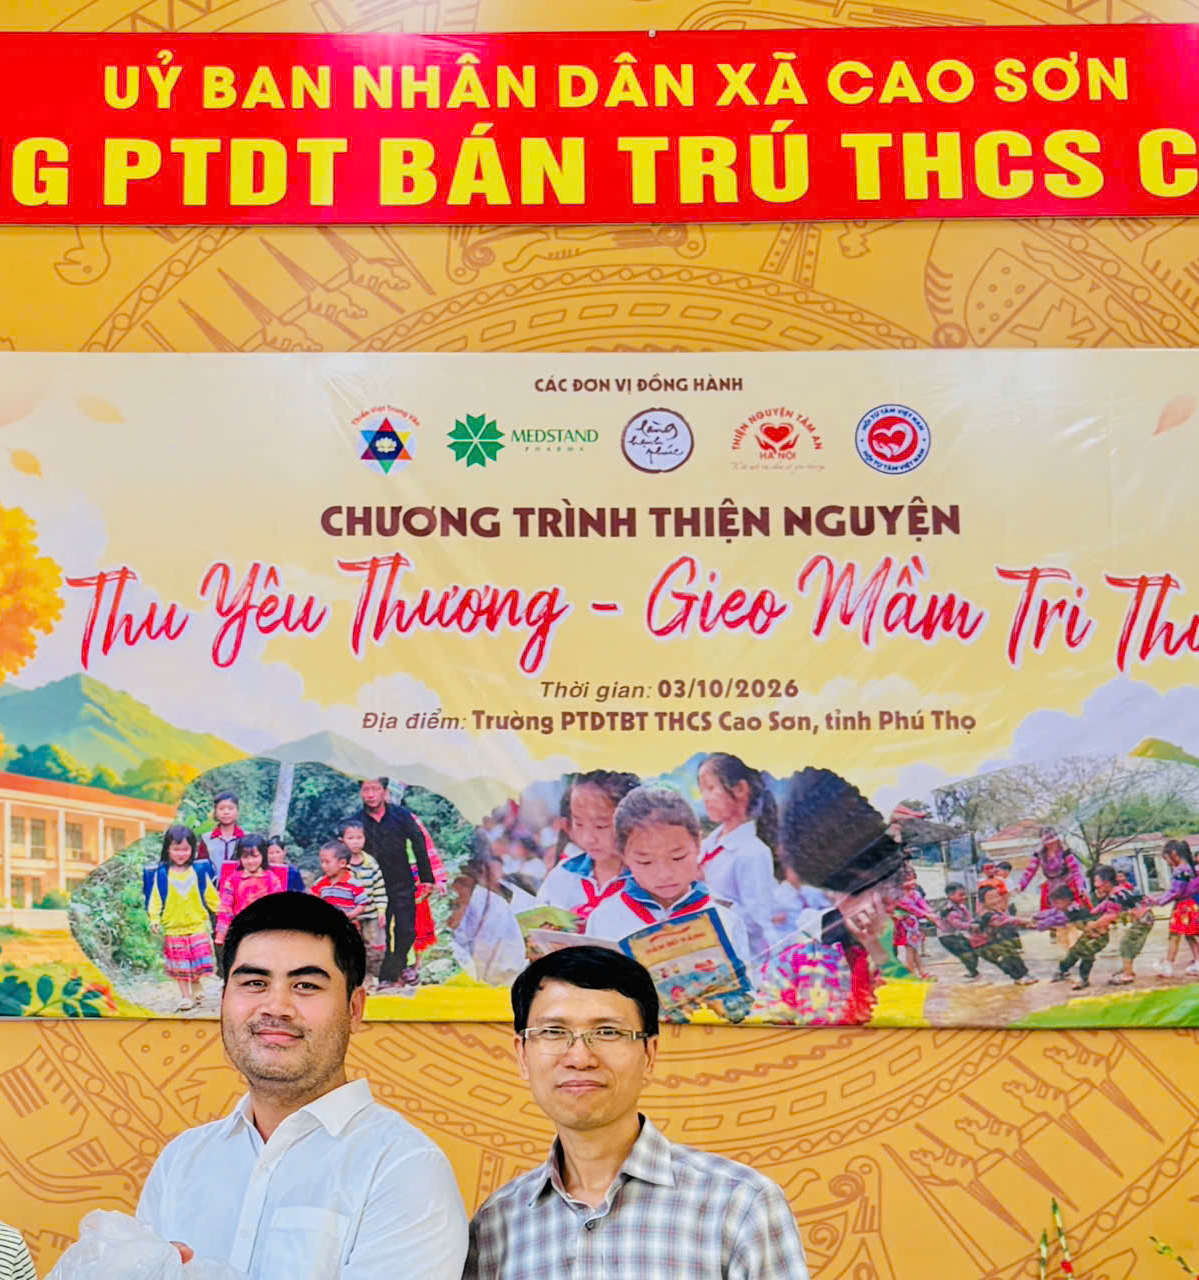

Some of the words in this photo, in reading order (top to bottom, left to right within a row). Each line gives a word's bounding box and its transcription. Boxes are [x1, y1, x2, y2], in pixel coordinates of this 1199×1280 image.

[104, 50, 183, 110] UỶ
[203, 65, 331, 110] BAN
[353, 52, 536, 110] NHÂN
[558, 53, 696, 109] DÂN
[716, 53, 809, 107] XÃ
[827, 58, 976, 106] CAO
[994, 52, 1129, 104] SƠN
[103, 137, 348, 207] PTDT
[379, 123, 587, 207] BÁN
[617, 120, 811, 205] TRÚ
[841, 128, 1106, 201] THCS
[534, 375, 567, 393] CÁC
[572, 378, 611, 392] ĐƠN
[615, 378, 632, 394] VỊ
[637, 373, 688, 393] ĐỒNG
[694, 374, 743, 391] HÀNH
[511, 428, 599, 443] MEDSTAND
[320, 504, 501, 538] CHƯƠNG
[512, 499, 637, 538] TRÌNH
[649, 498, 770, 543] THIỆN
[783, 496, 961, 542] NGUYỆN
[65, 566, 189, 671] Thu
[199, 562, 327, 668] Yêu
[336, 552, 568, 673] Thương
[646, 555, 788, 638] Gieo
[797, 555, 987, 645] Mầm
[540, 680, 589, 699] Thời
[595, 686, 653, 703] gian:
[657, 677, 799, 699] 03/10/2026
[362, 711, 398, 734] Địa
[405, 709, 466, 731] điểm:
[472, 709, 554, 734] Trường
[561, 711, 648, 731] PTDTBT
[654, 711, 712, 732] THCS
[718, 711, 762, 732] Cao
[769, 710, 819, 735] Sơn,
[825, 708, 871, 731] tỉnh
[878, 709, 925, 731] Phú
[930, 710, 977, 735] Thọ
